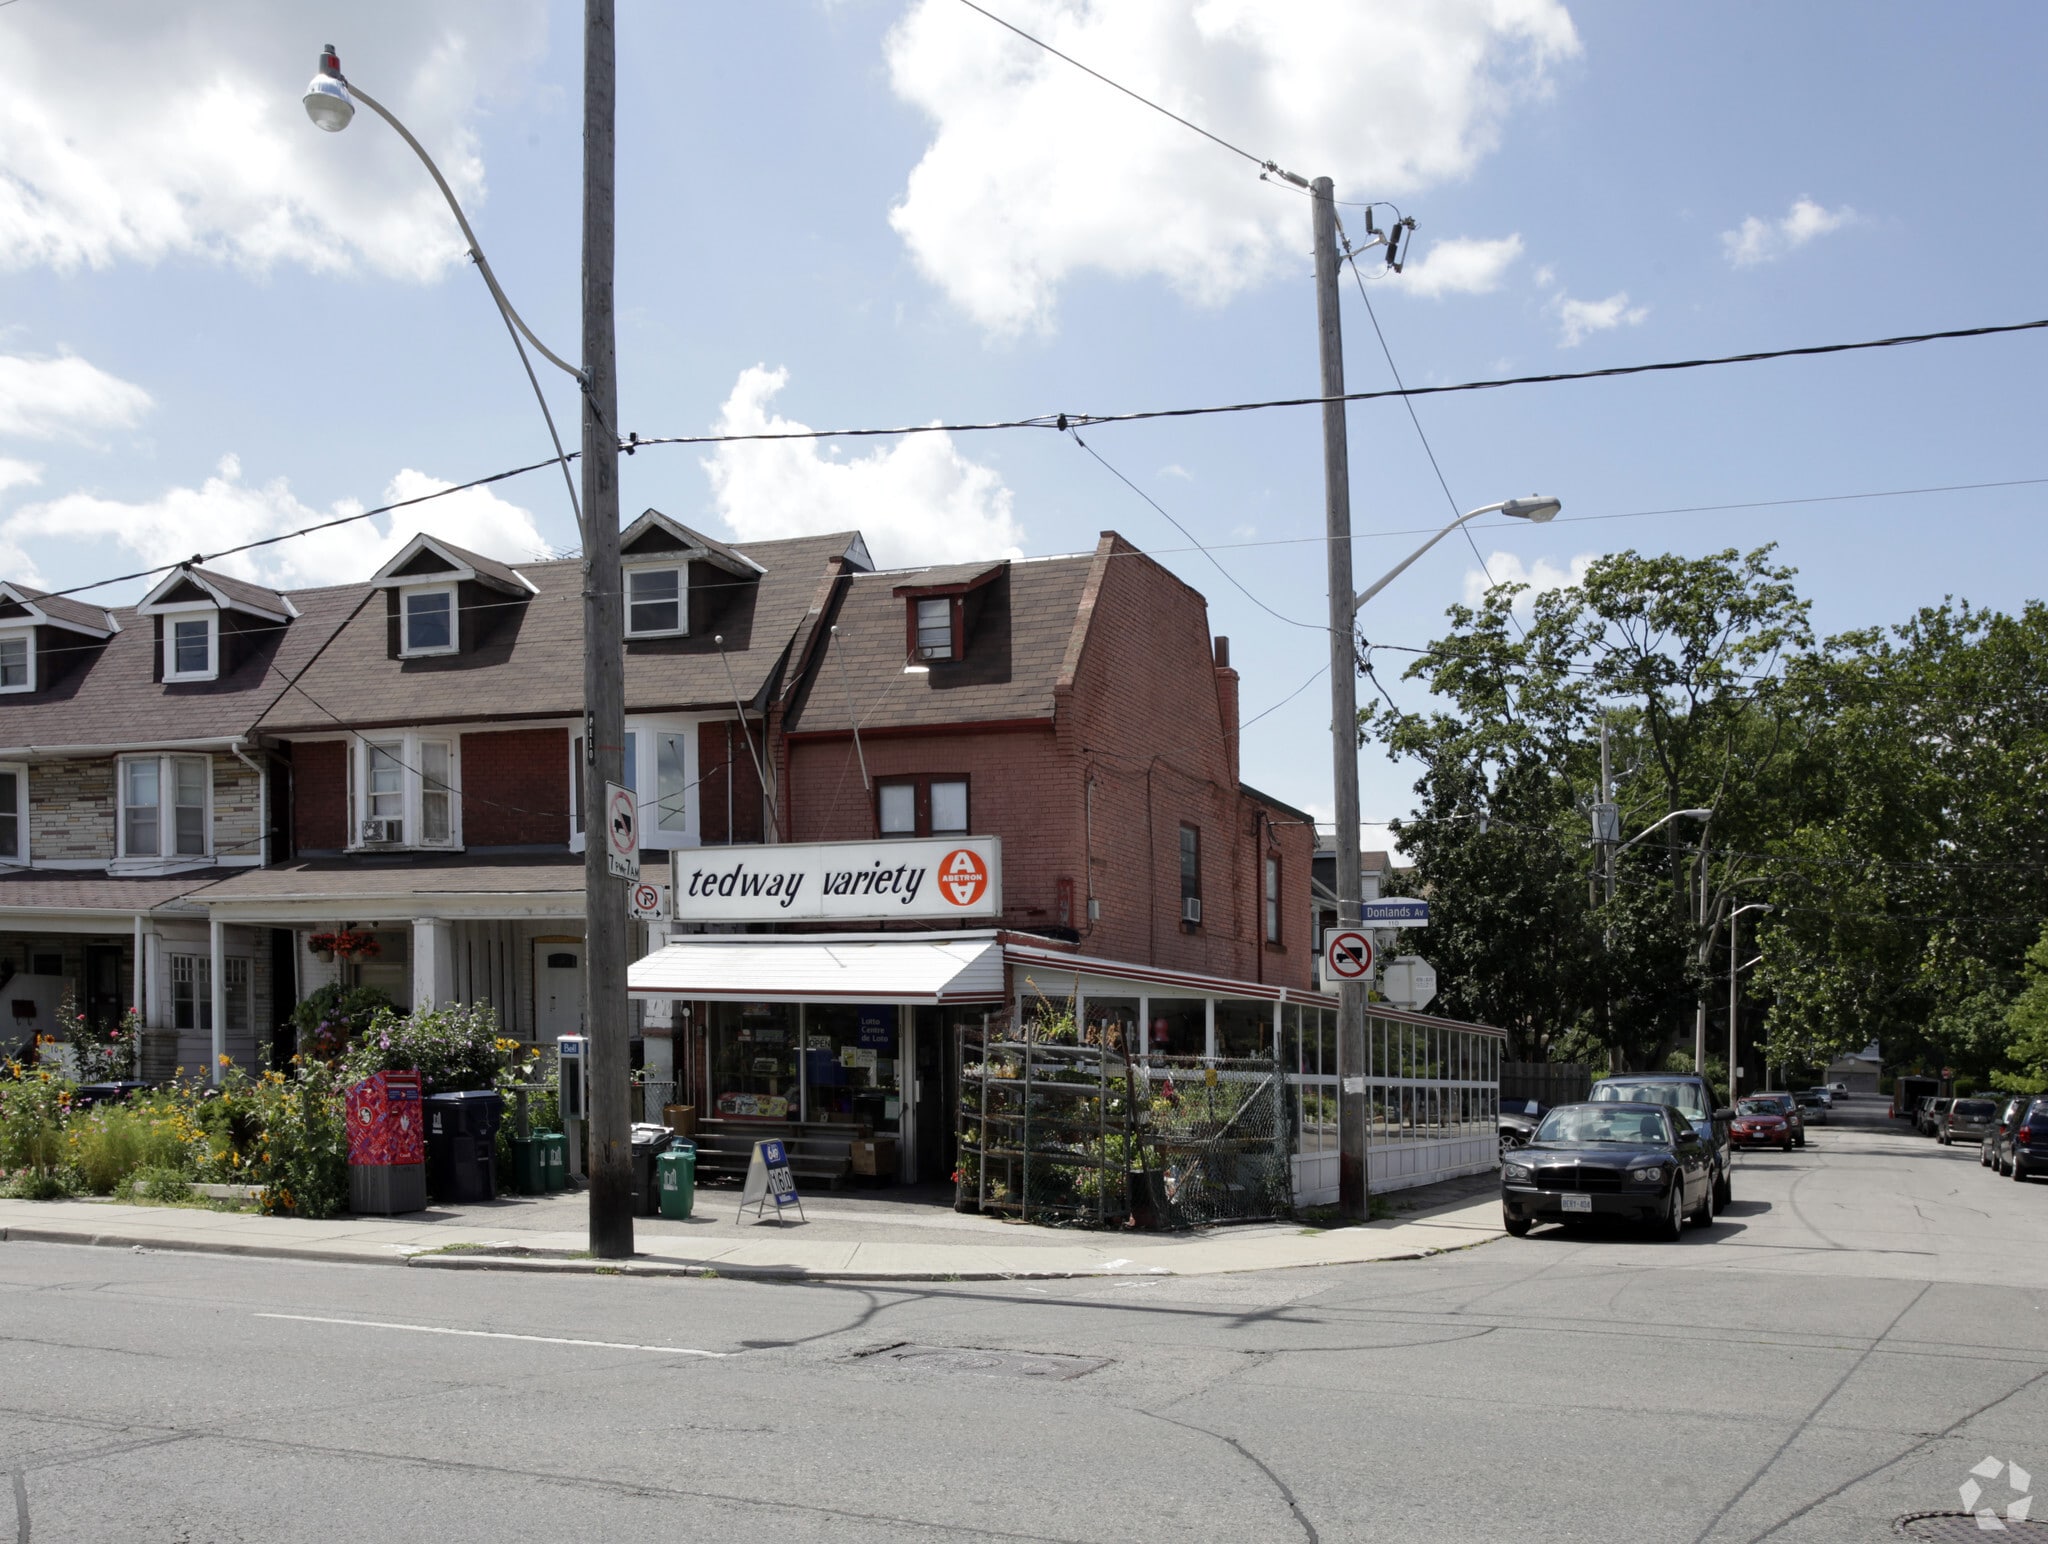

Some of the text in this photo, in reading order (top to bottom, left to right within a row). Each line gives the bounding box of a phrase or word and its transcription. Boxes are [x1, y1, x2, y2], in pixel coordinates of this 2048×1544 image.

[942, 873, 983, 882] ABETRON
[688, 860, 927, 908] tedway variety
[1367, 906, 1424, 918] Donlands Av
[861, 1026, 885, 1034] Centre
[861, 1034, 889, 1042] de Loto
[563, 1042, 577, 1053] Bell
[808, 1039, 831, 1048] OPEN
[771, 1170, 793, 1192] 160
